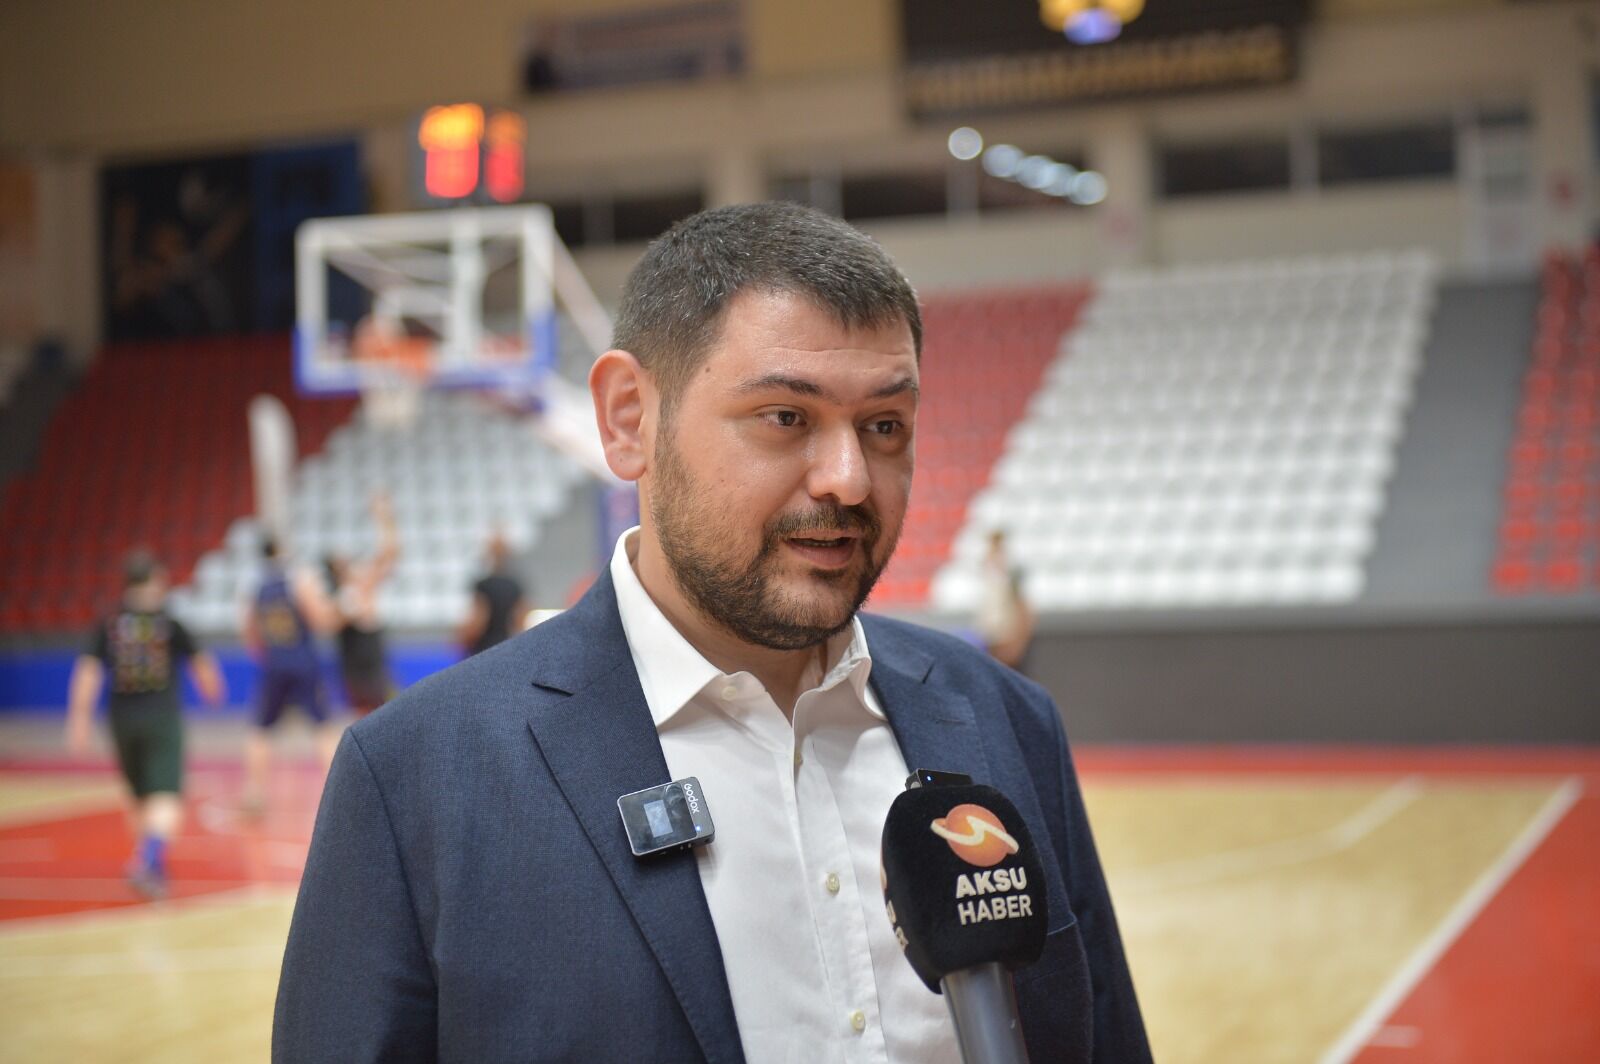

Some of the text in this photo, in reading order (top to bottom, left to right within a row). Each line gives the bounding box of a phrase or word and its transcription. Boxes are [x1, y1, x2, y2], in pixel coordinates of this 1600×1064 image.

[684, 783, 700, 814] Godox
[955, 867, 1027, 899] AKSU
[957, 895, 1033, 926] HABER
